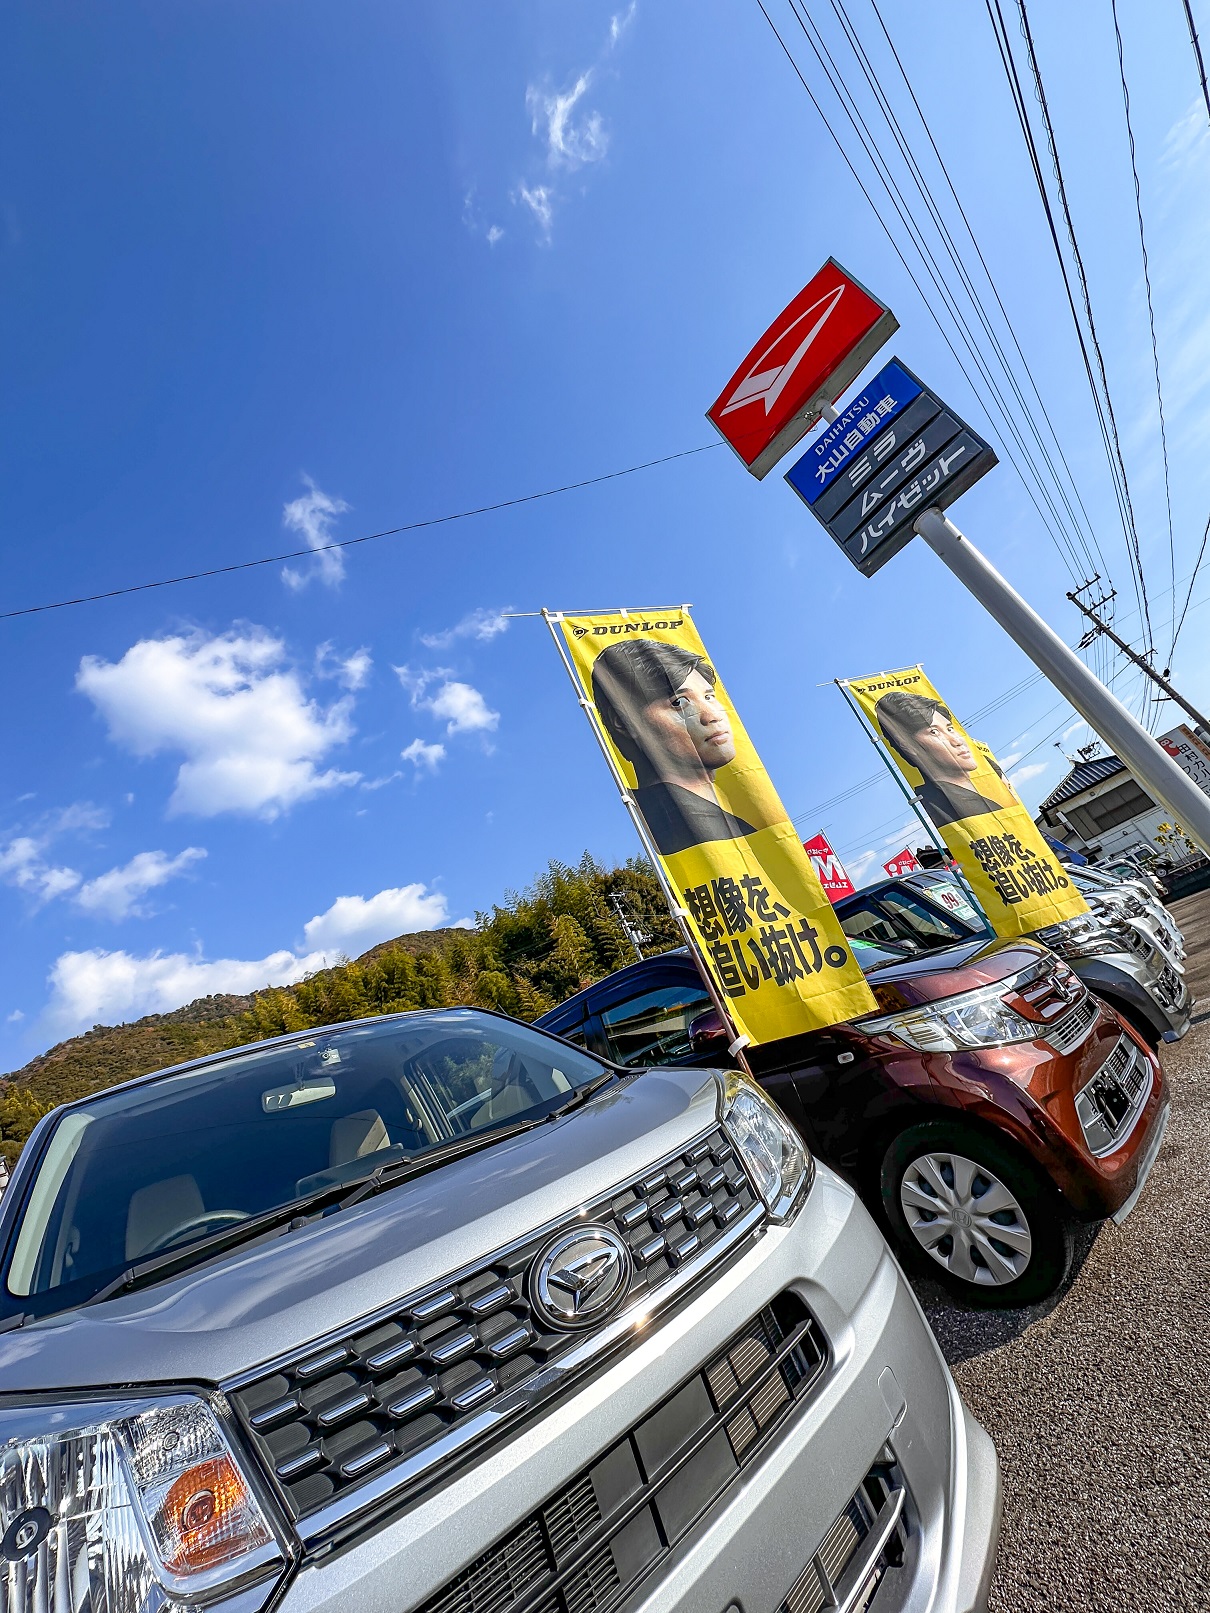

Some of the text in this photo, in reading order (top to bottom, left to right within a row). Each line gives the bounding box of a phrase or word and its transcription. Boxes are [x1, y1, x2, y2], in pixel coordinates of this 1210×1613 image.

[814, 396, 870, 456] DAIHATSU
[815, 394, 898, 484] 大山自動車
[848, 430, 897, 488] ミラ
[861, 439, 927, 517] ムーヴ
[860, 445, 966, 554] ハイゼット
[592, 620, 684, 636] DUNLOP
[867, 675, 921, 692] DUNLOP
[1178, 743, 1210, 779] 田村カル
[969, 833, 1036, 872] 想像を、
[683, 874, 791, 941] 想像を、
[988, 858, 1069, 907] 追い抜け。
[706, 918, 848, 998] 追い抜け。
